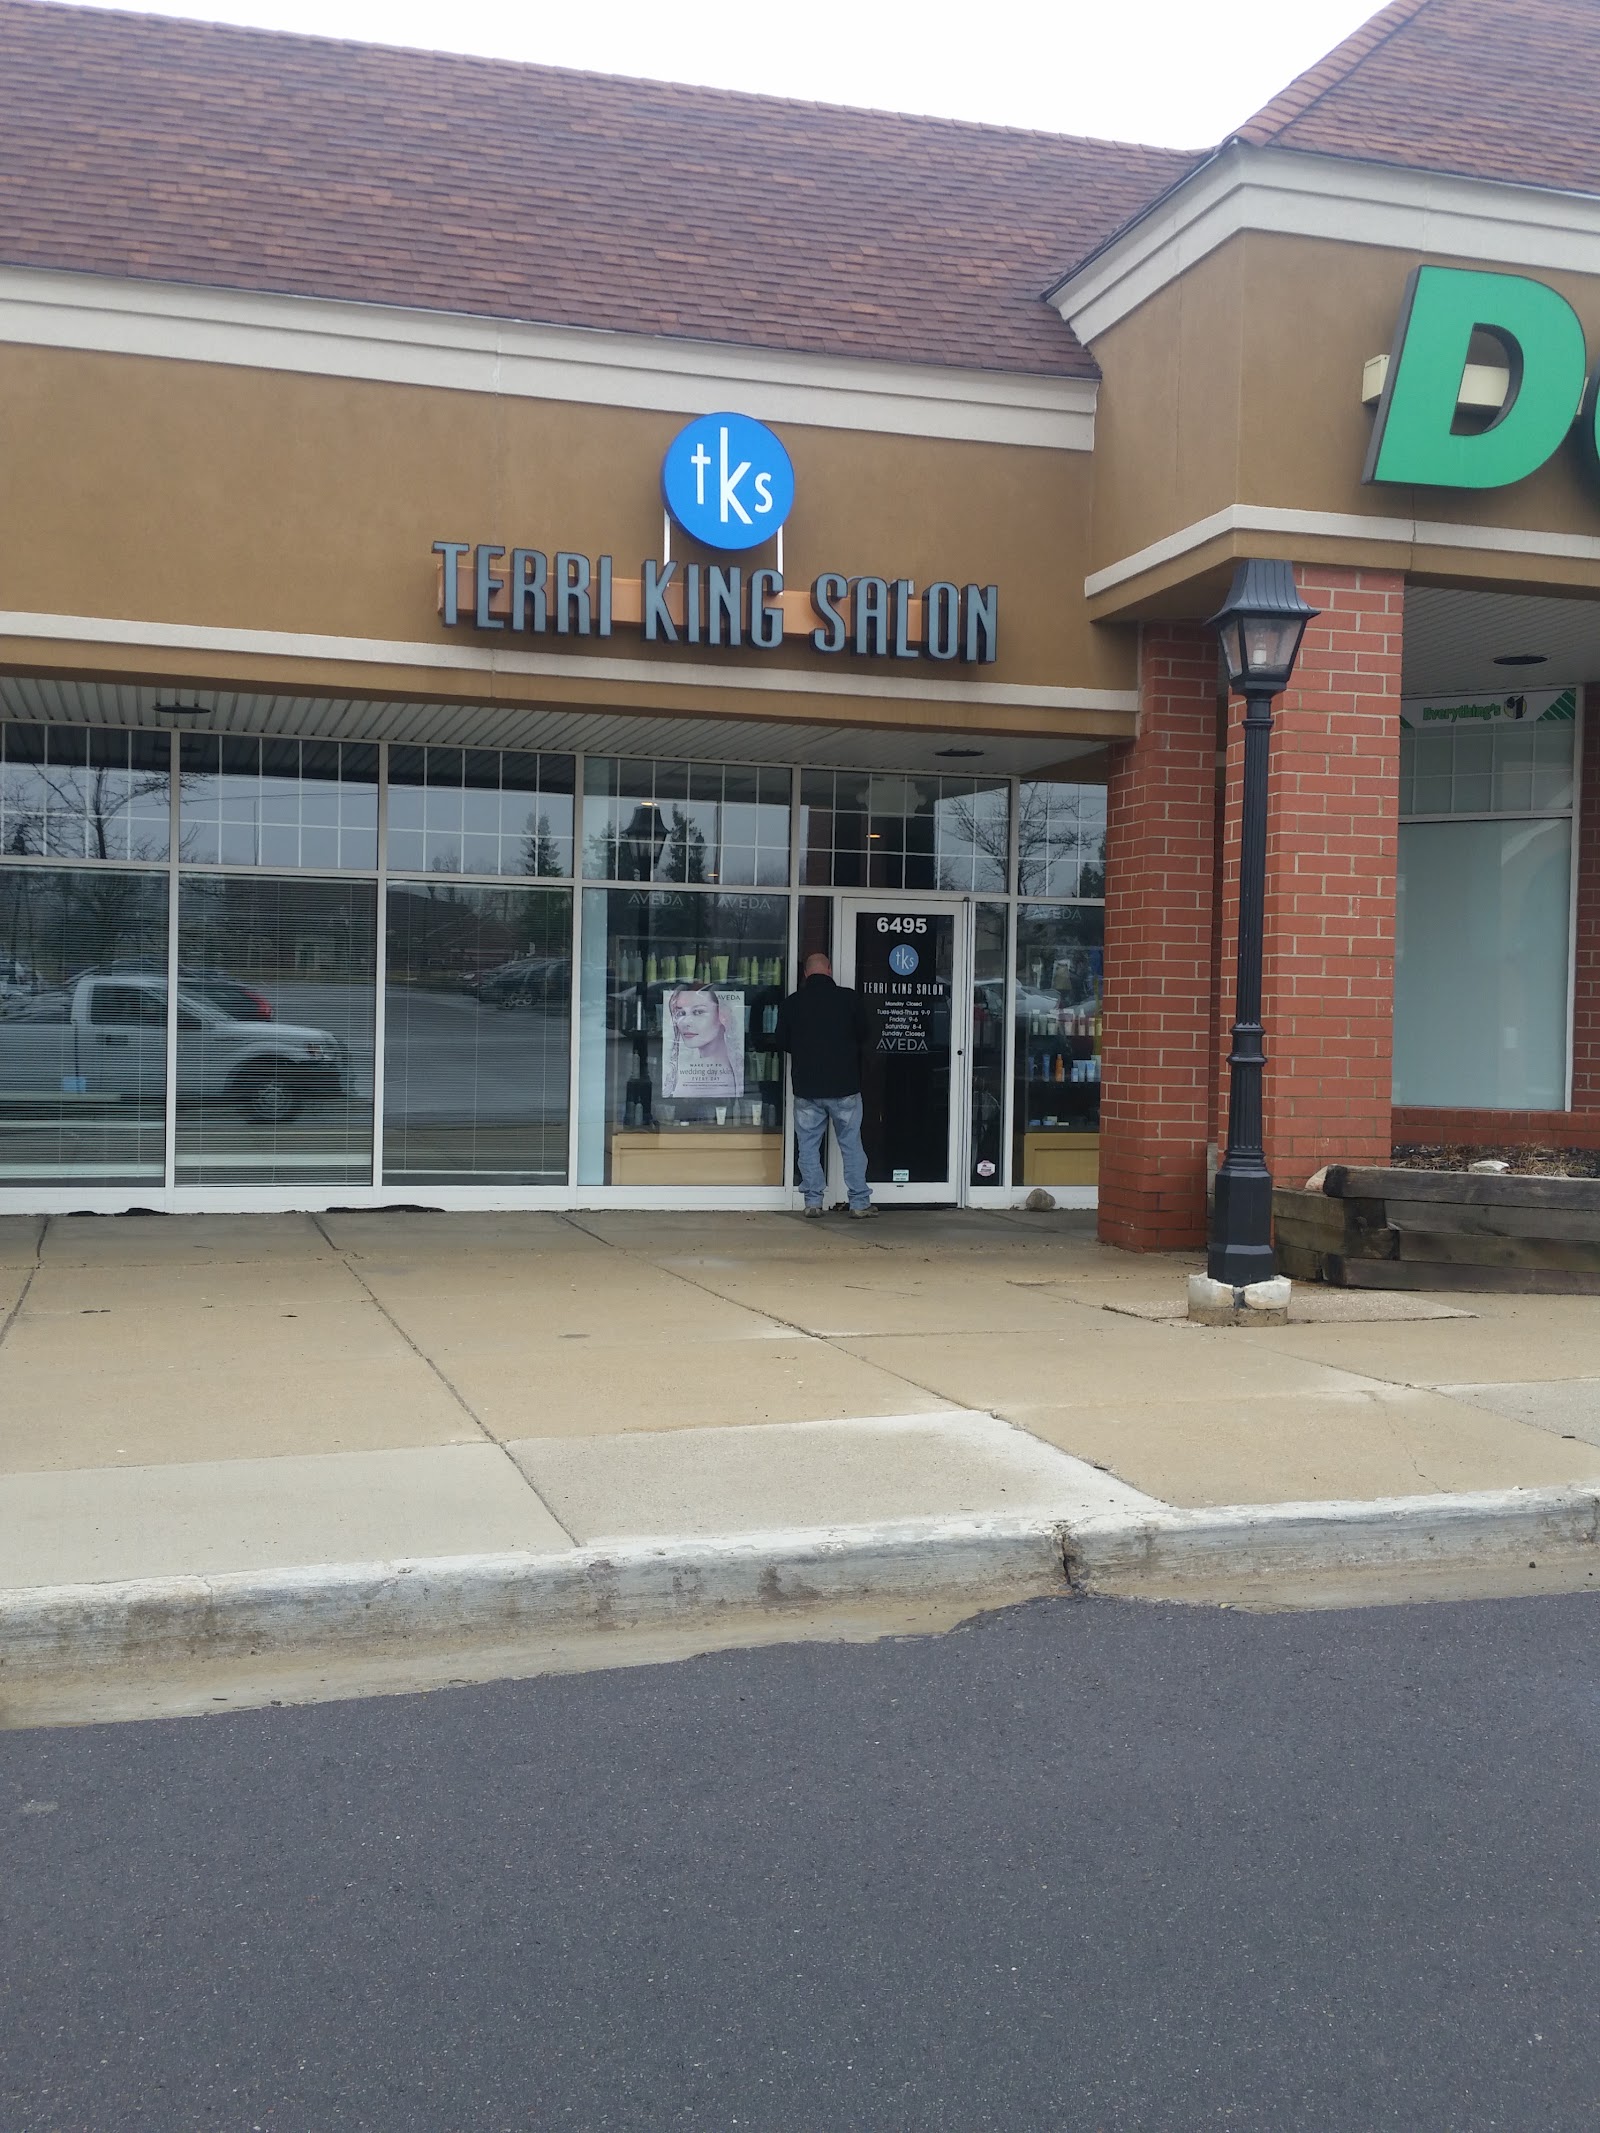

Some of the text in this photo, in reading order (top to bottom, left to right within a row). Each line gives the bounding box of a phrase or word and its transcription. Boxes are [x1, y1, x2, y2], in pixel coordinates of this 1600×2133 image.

[1361, 264, 1600, 490] D
[690, 426, 773, 525] tks
[432, 540, 998, 665] TERRI KING SALON
[1422, 703, 1501, 723] Everything's
[628, 890, 684, 906] AVEDA
[716, 896, 771, 910] AVEDA
[876, 917, 928, 934] 6495
[895, 947, 914, 970] tks
[863, 982, 944, 996] TERRI KING SALON
[876, 1038, 928, 1051] AVEDA
[680, 1068, 706, 1076] wedding
[707, 1068, 719, 1076] day
